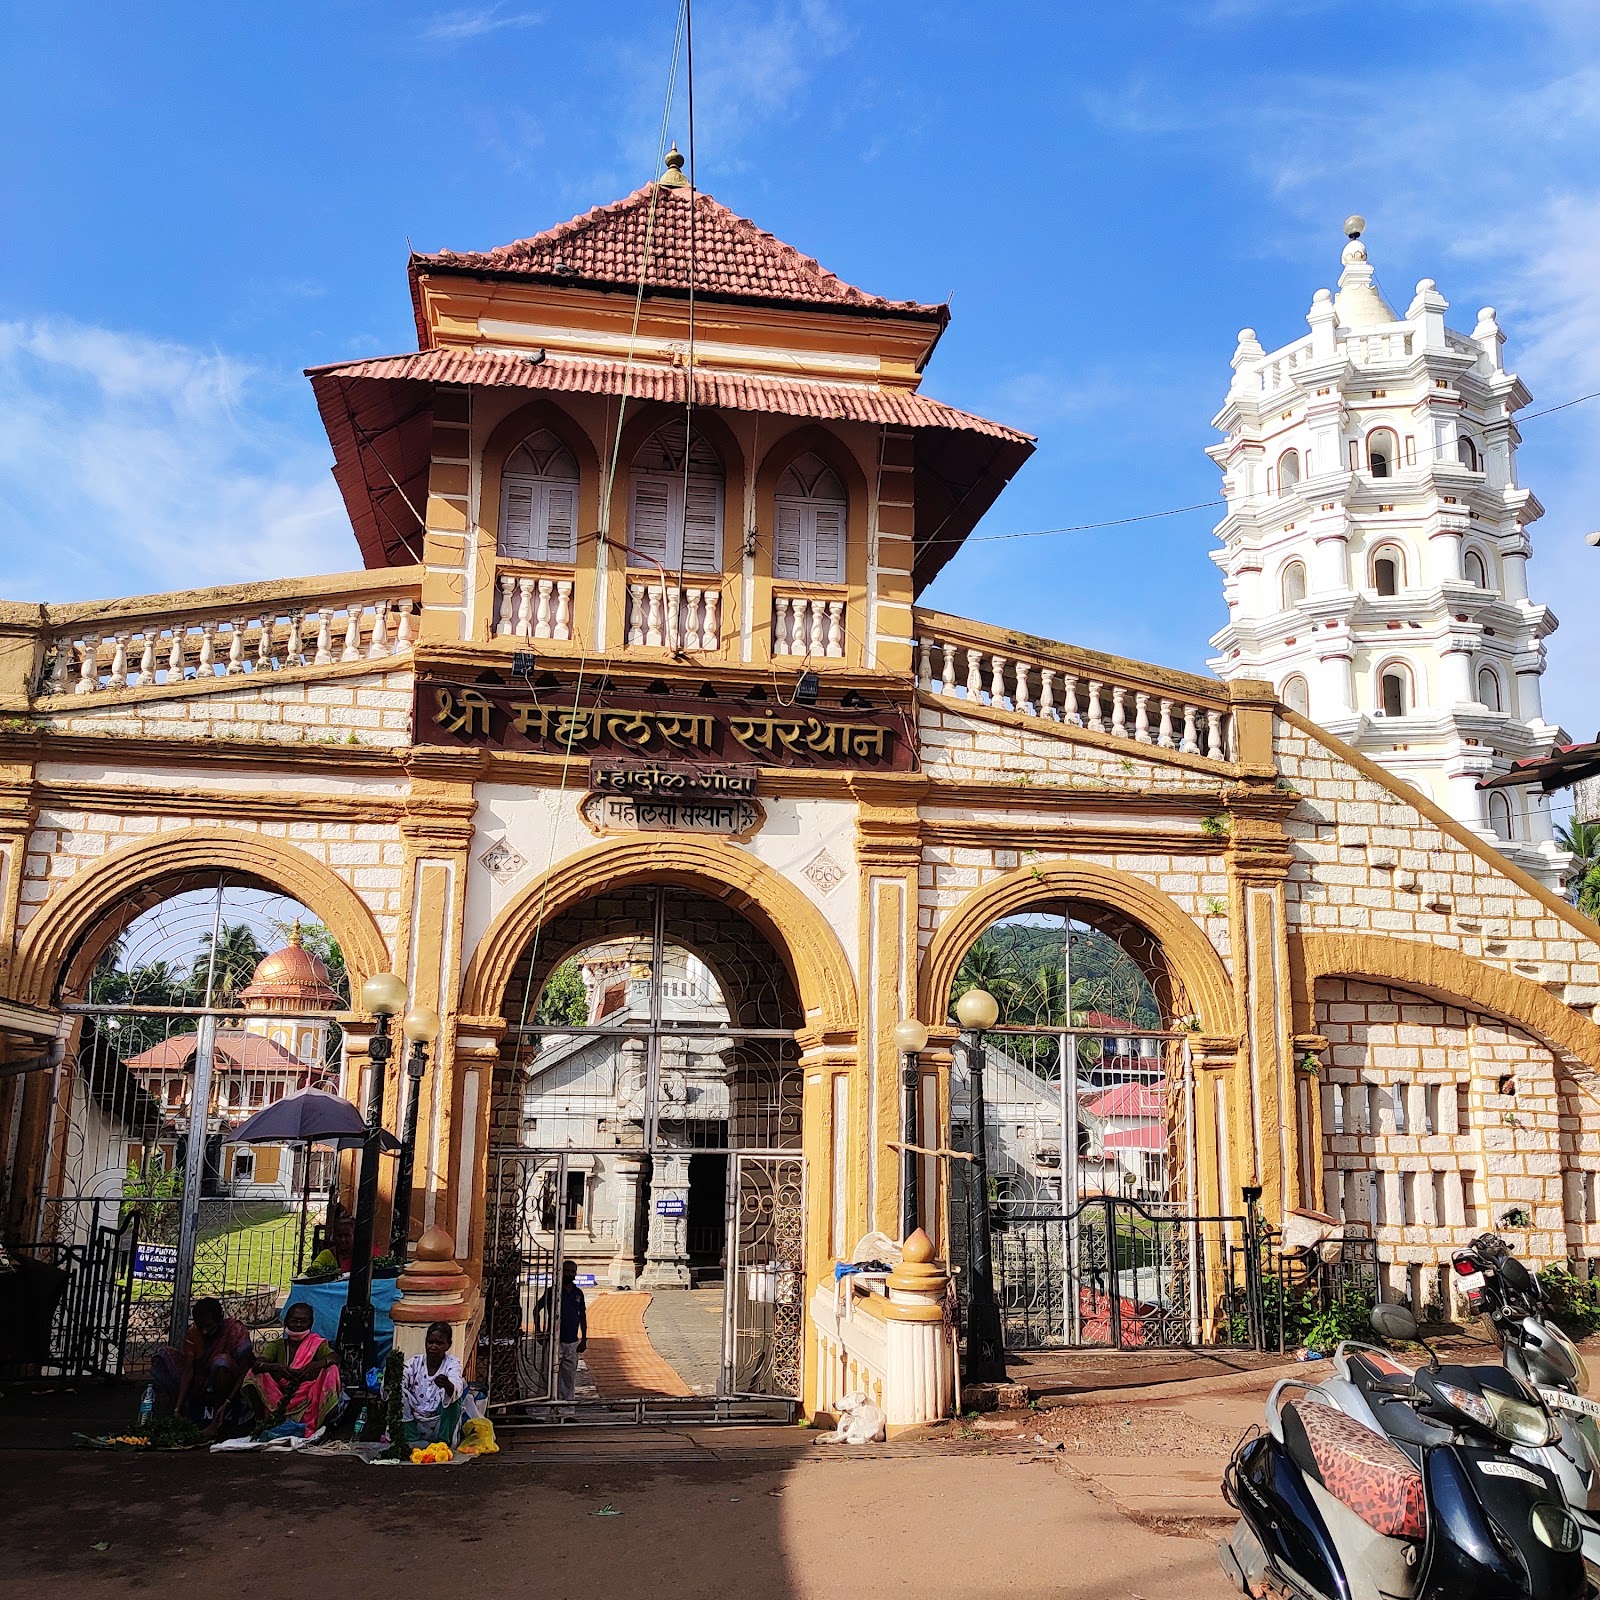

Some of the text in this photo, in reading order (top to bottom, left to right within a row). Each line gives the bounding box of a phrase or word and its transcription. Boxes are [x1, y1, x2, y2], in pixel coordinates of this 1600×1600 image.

[432, 688, 892, 757] श्री महालसा संस्थान
[608, 801, 678, 826] महालसा
[809, 866, 842, 882] 1560
[1542, 1392, 1555, 1402] GA
